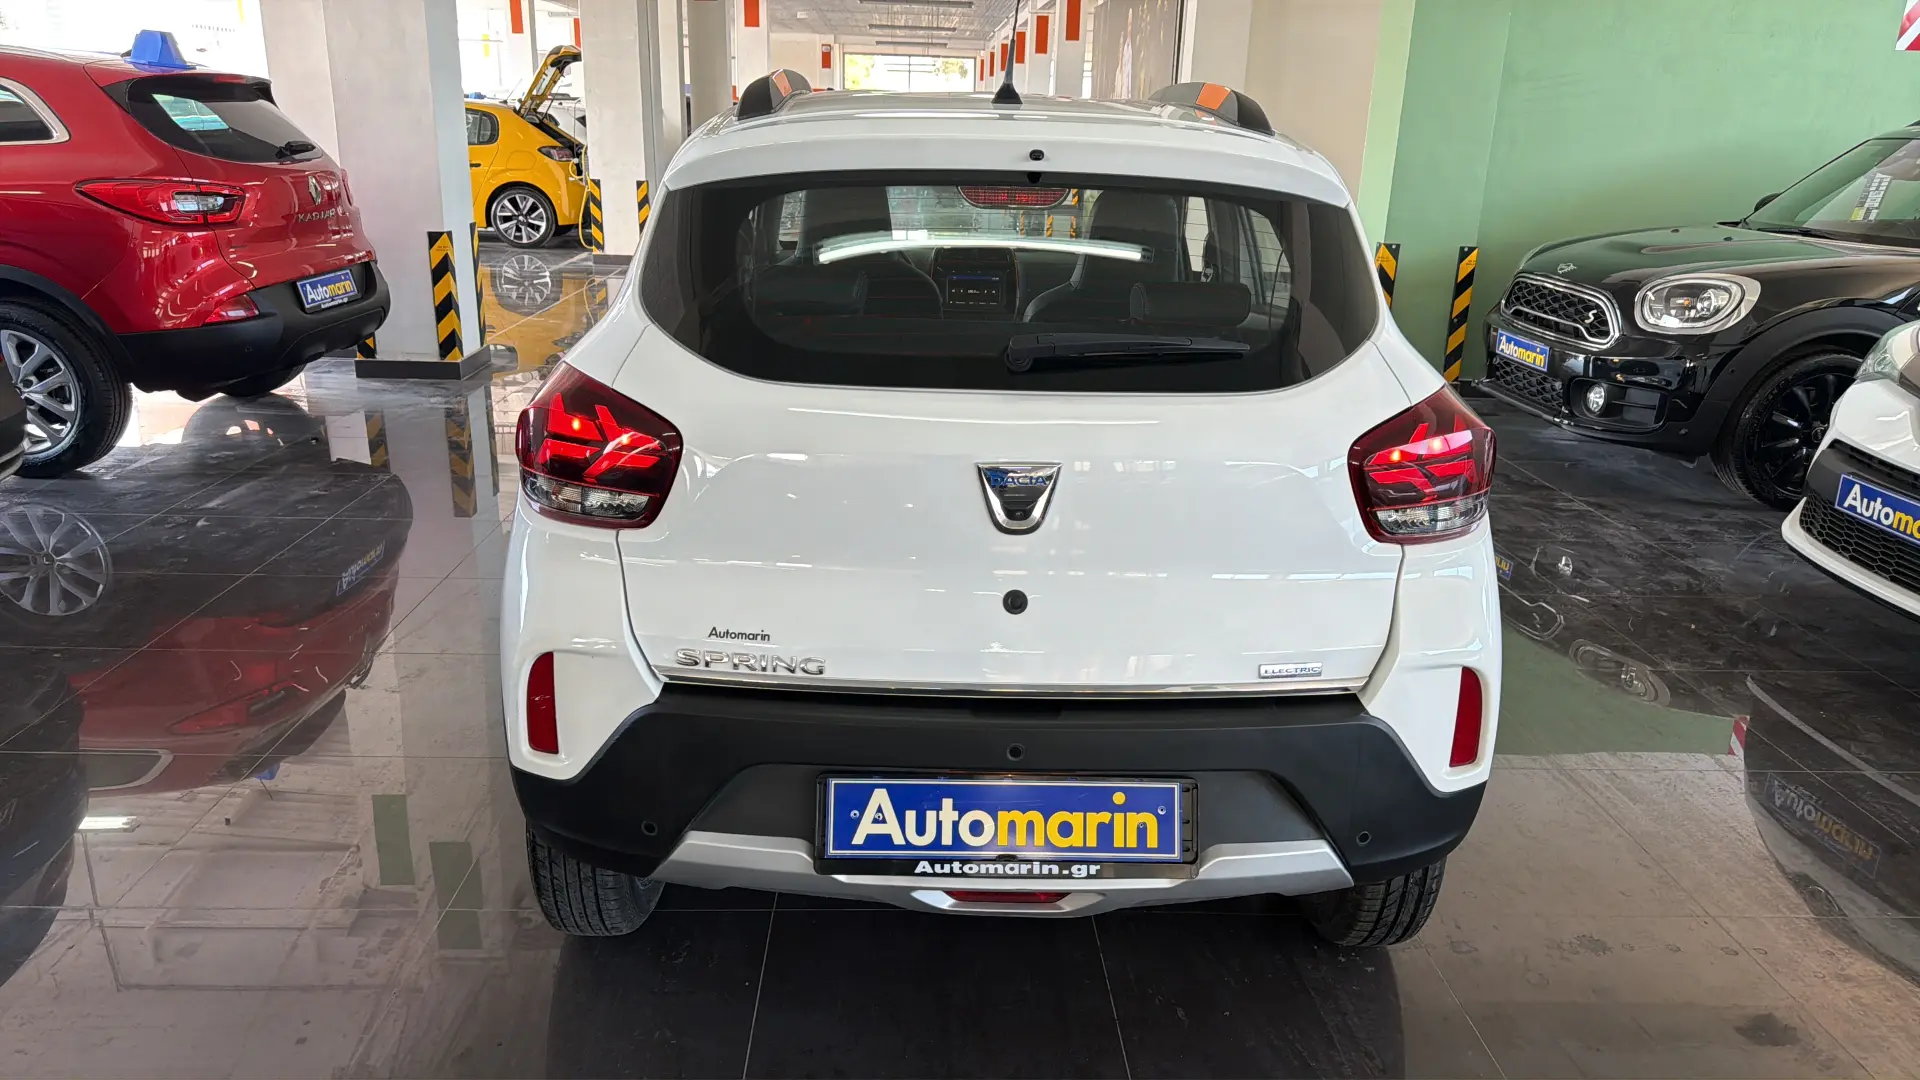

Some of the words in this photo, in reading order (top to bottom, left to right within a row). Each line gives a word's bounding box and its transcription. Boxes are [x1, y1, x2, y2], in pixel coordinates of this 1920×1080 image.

[305, 275, 354, 303] Automarin
[1499, 334, 1546, 368] Automarin
[990, 474, 1048, 488] DACIA
[708, 626, 771, 642] Automarin
[676, 648, 826, 676] SPRING
[1264, 666, 1321, 675] ELECTRIC
[851, 788, 1159, 849] Automarin
[914, 860, 1101, 878] Automarin.gr
